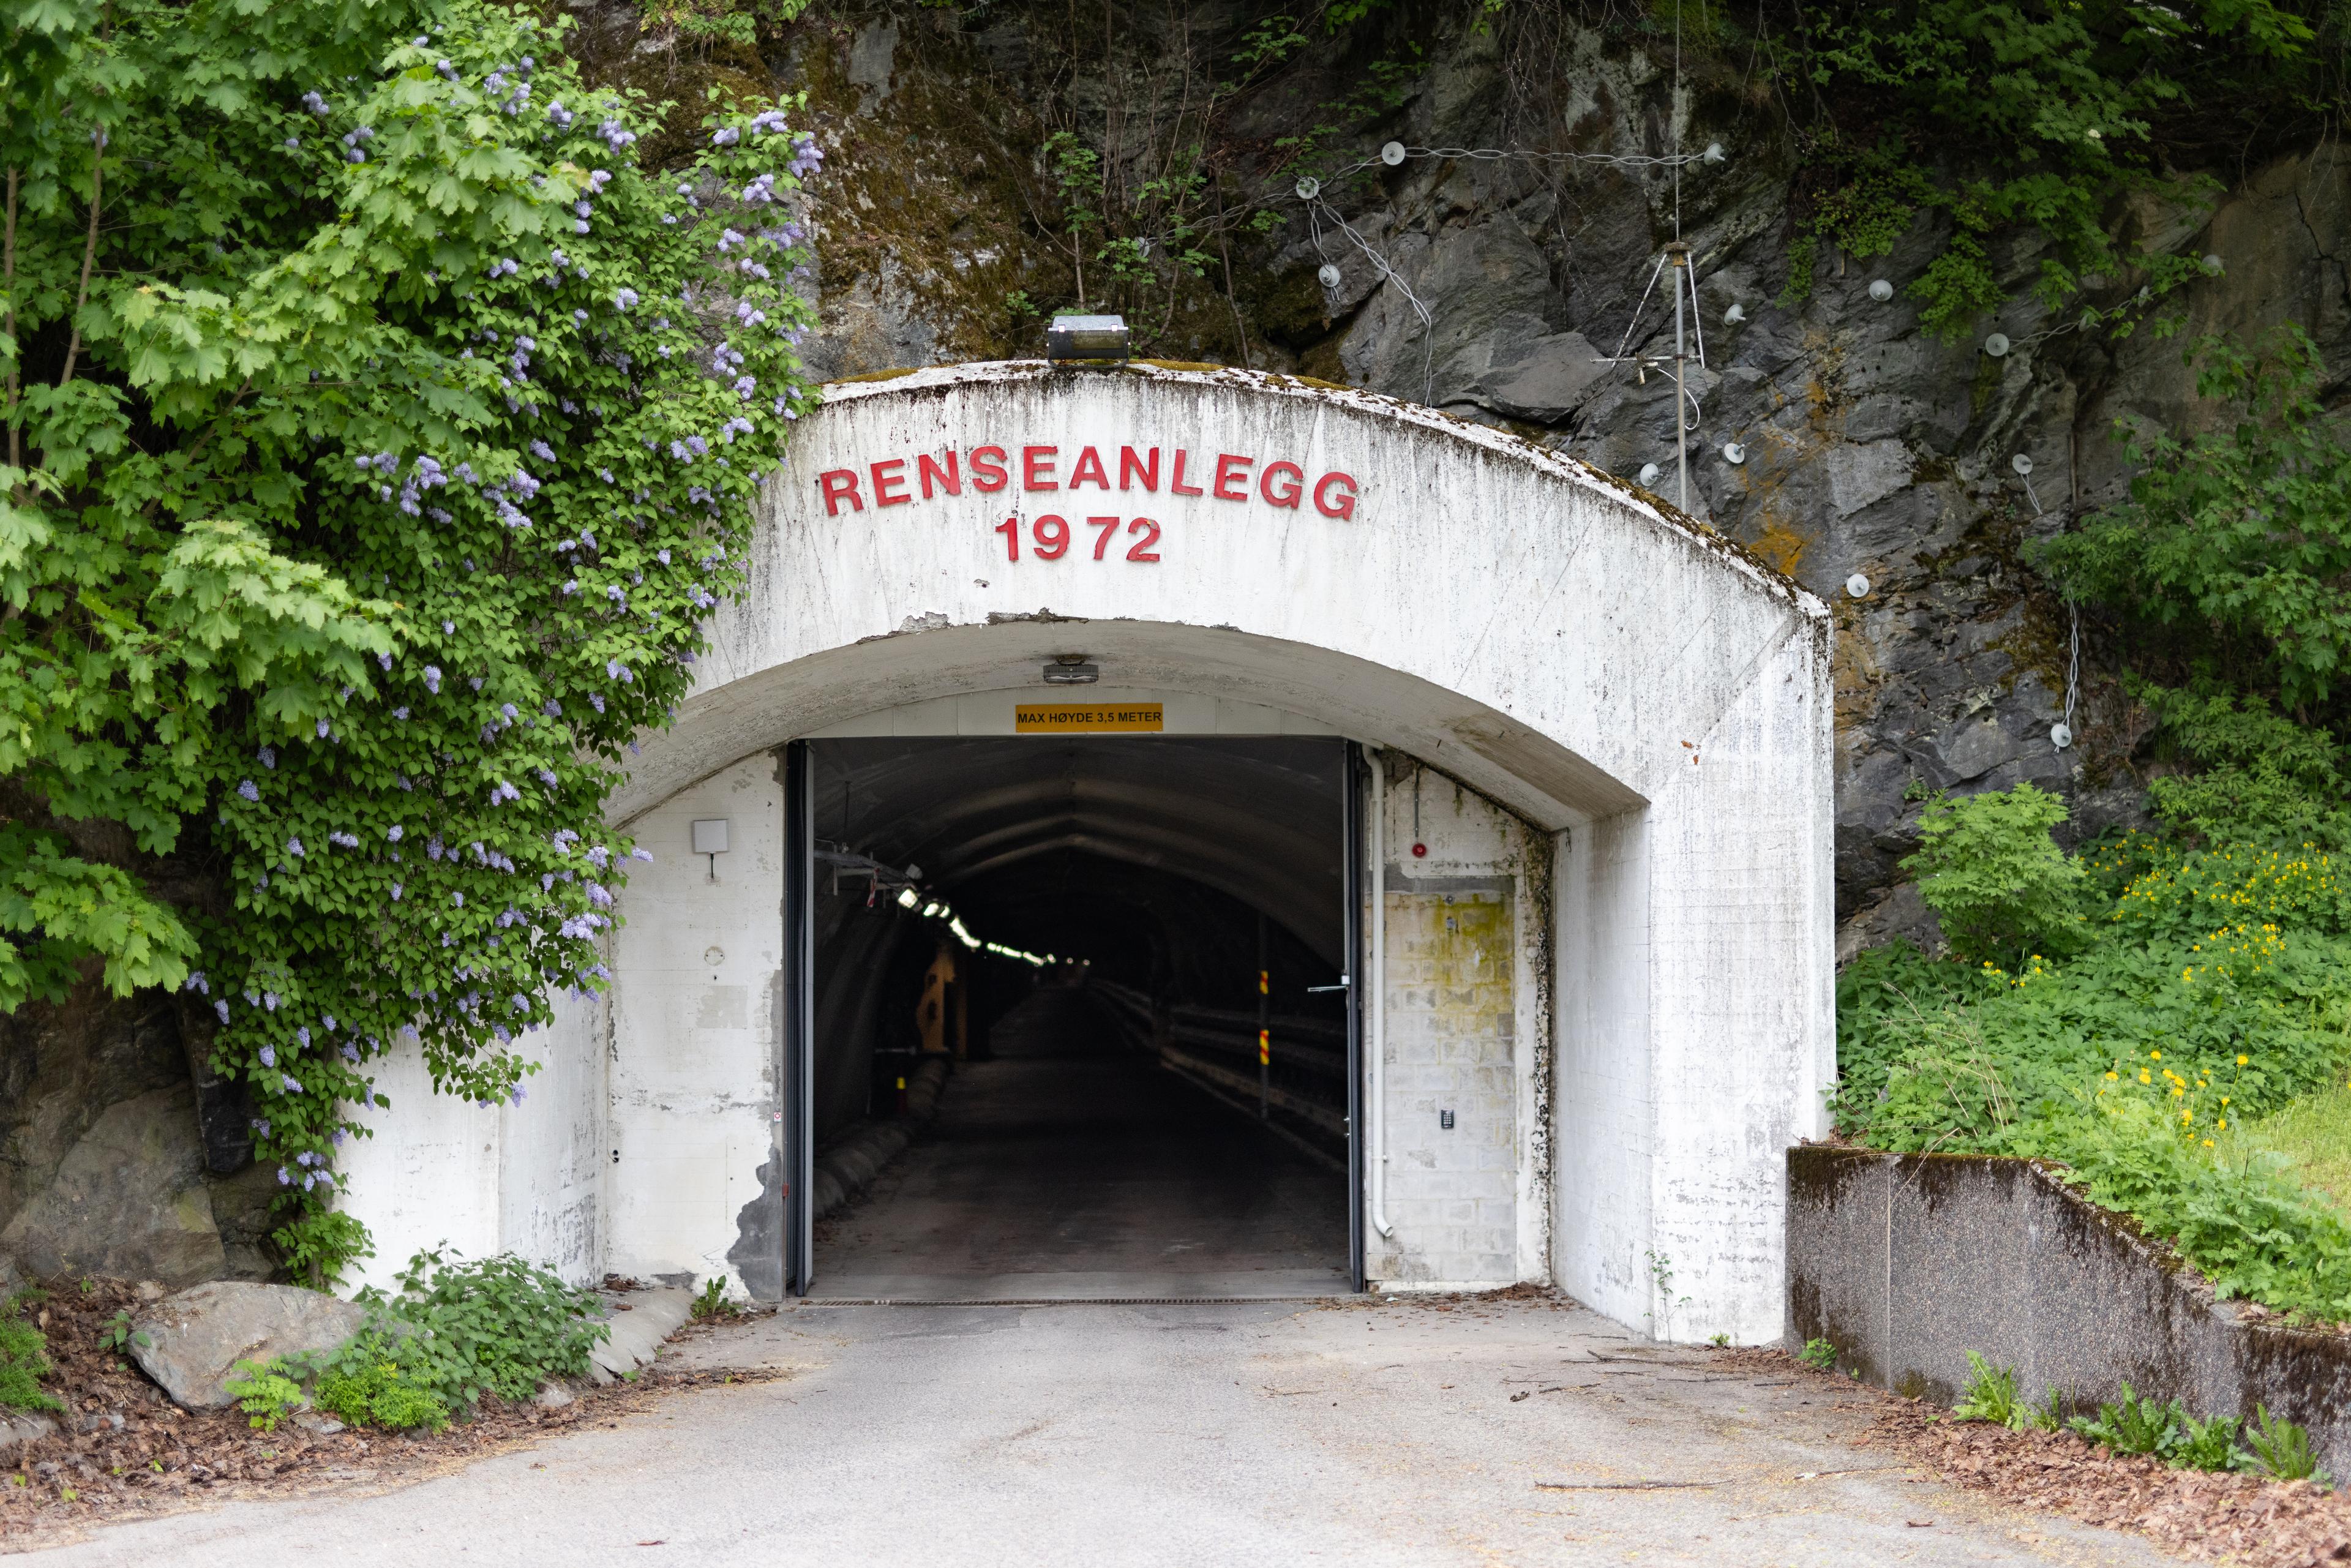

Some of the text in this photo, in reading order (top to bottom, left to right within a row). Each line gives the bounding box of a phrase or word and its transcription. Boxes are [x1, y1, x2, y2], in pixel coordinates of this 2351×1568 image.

[820, 445, 1357, 520] RENSEANLEGG
[995, 514, 1161, 562] 1972
[1017, 711, 1161, 724] MAX HØYDE 3,5 METER
